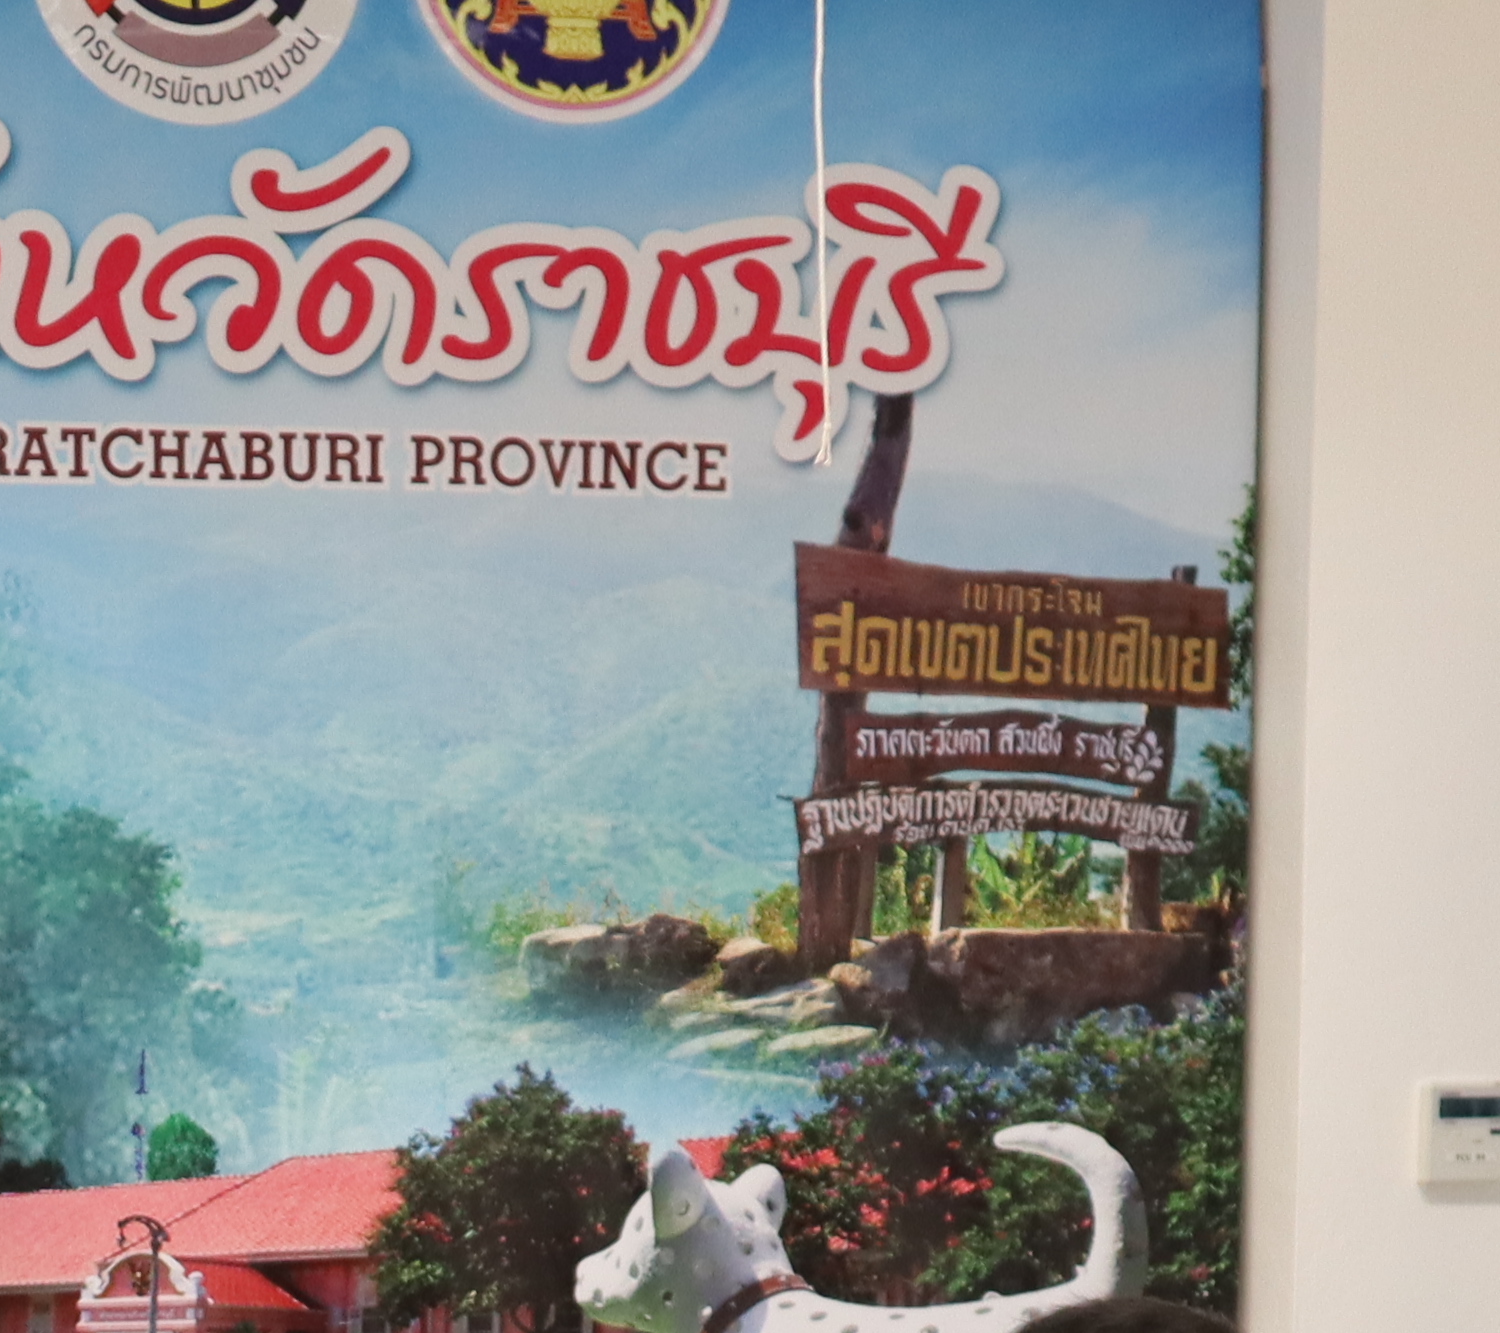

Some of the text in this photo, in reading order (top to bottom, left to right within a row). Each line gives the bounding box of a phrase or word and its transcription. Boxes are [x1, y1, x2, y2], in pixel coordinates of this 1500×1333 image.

[72, 22, 322, 107] กรมการพัฒนาชุมชน
[410, 434, 730, 494] PROVINCE
[962, 577, 1102, 616] เขากระโจม
[811, 600, 1218, 693] สุดเขตประเทศไทย
[856, 718, 990, 758] ภาคตะวันตก
[998, 714, 1063, 757] สวนผึ้ง
